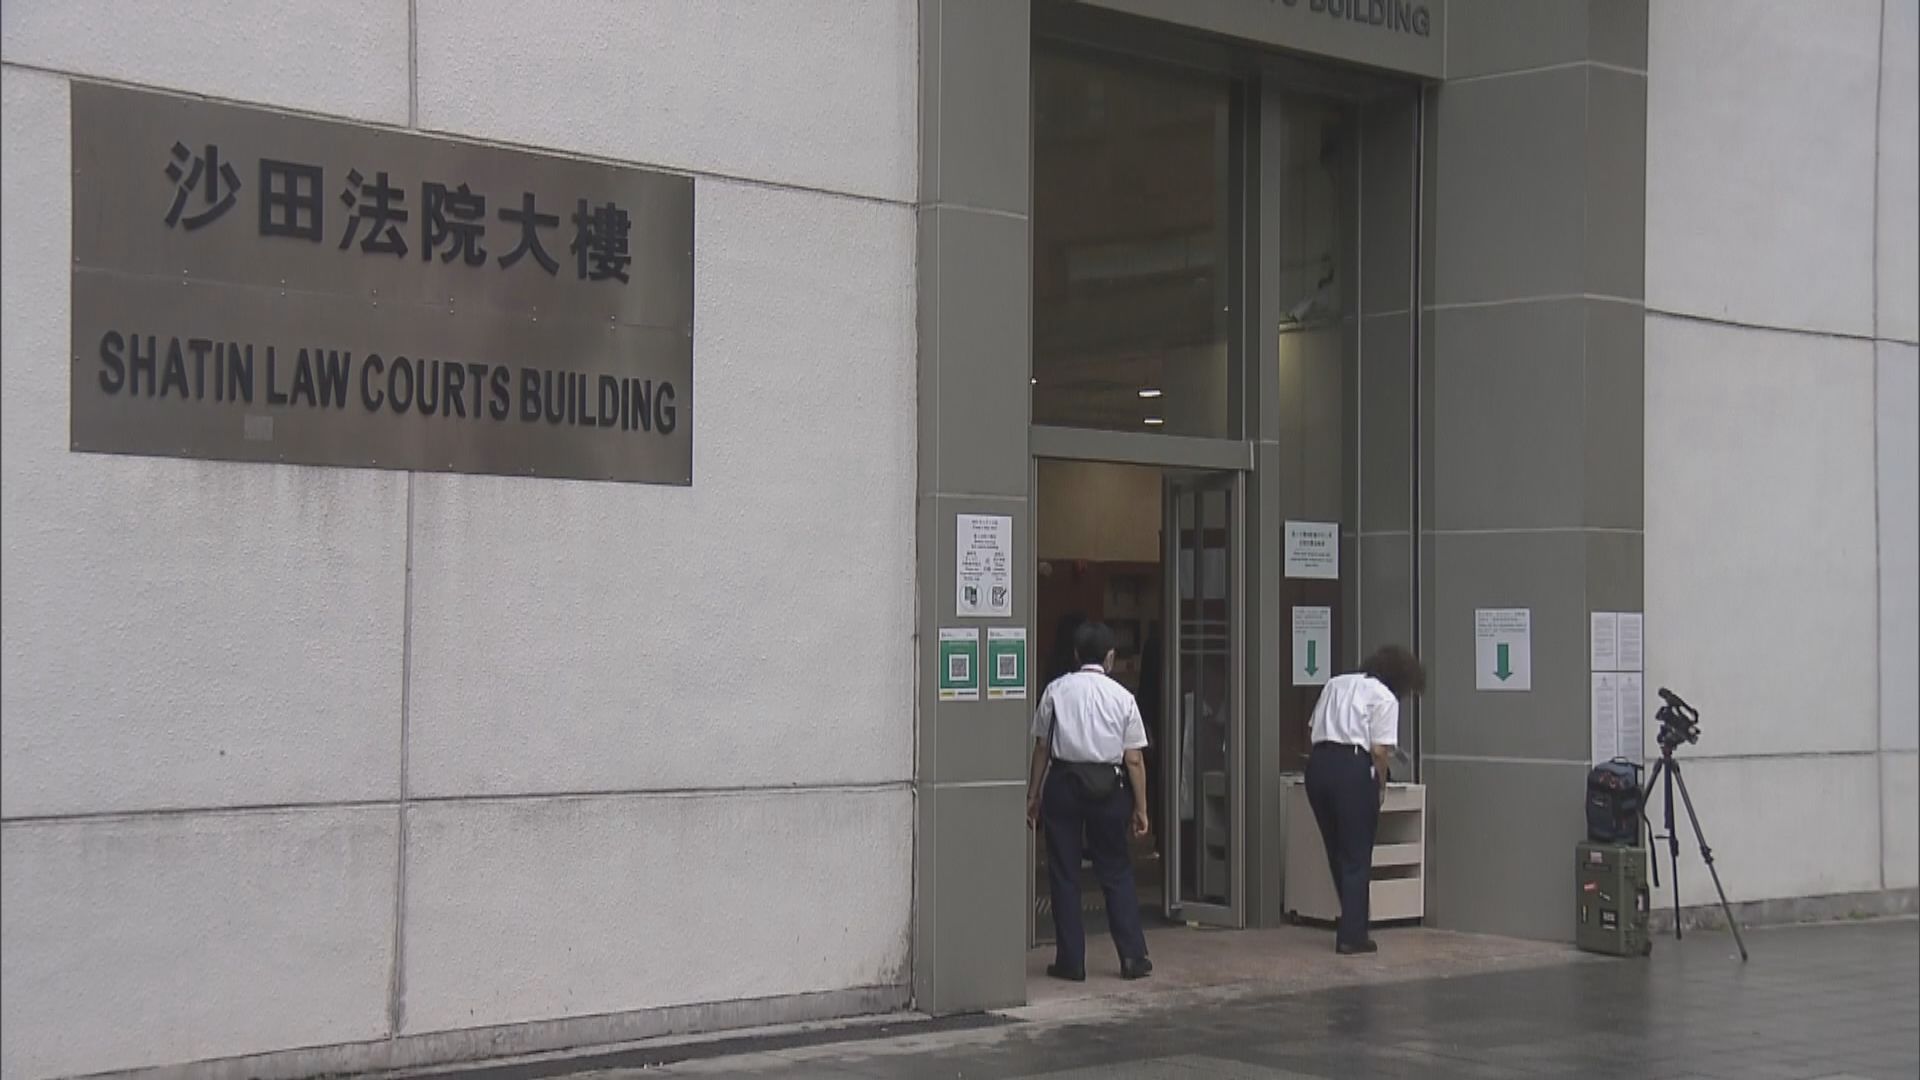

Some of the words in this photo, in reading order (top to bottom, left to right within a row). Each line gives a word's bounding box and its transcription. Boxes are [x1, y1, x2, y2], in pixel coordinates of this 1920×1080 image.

[164, 141, 632, 284] 沙田法院大樓
[99, 330, 253, 404] SHATIN
[266, 346, 351, 409] LAW
[360, 354, 510, 421] COURTS
[519, 367, 676, 435] BUILDING
